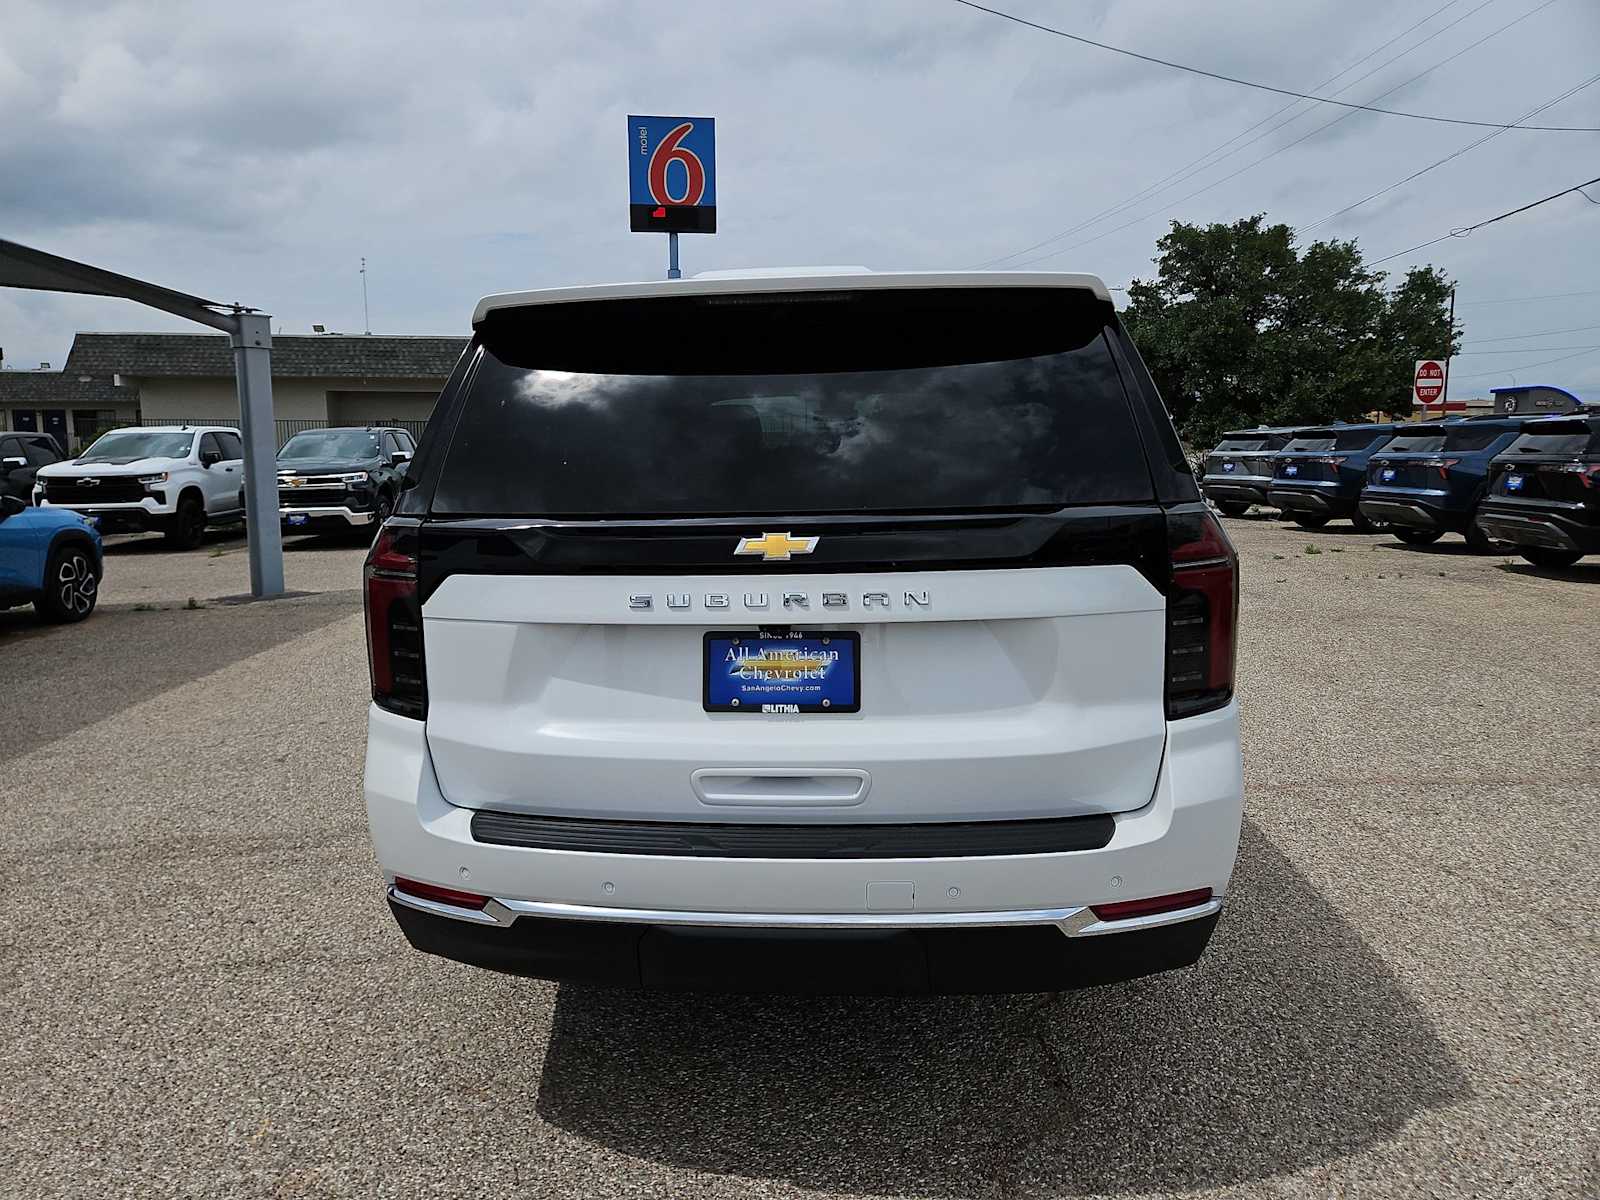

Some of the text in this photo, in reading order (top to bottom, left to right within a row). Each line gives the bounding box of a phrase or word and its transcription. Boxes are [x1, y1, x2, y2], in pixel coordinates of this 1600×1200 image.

[638, 126, 648, 155] motel
[648, 122, 705, 206] 6
[1420, 369, 1440, 377] DO NOT
[1420, 388, 1438, 396] ENTER
[628, 591, 930, 609] SUBURBAN
[725, 647, 839, 661] All American
[739, 666, 825, 680] Chevrolet
[770, 704, 800, 713] LITHIA
